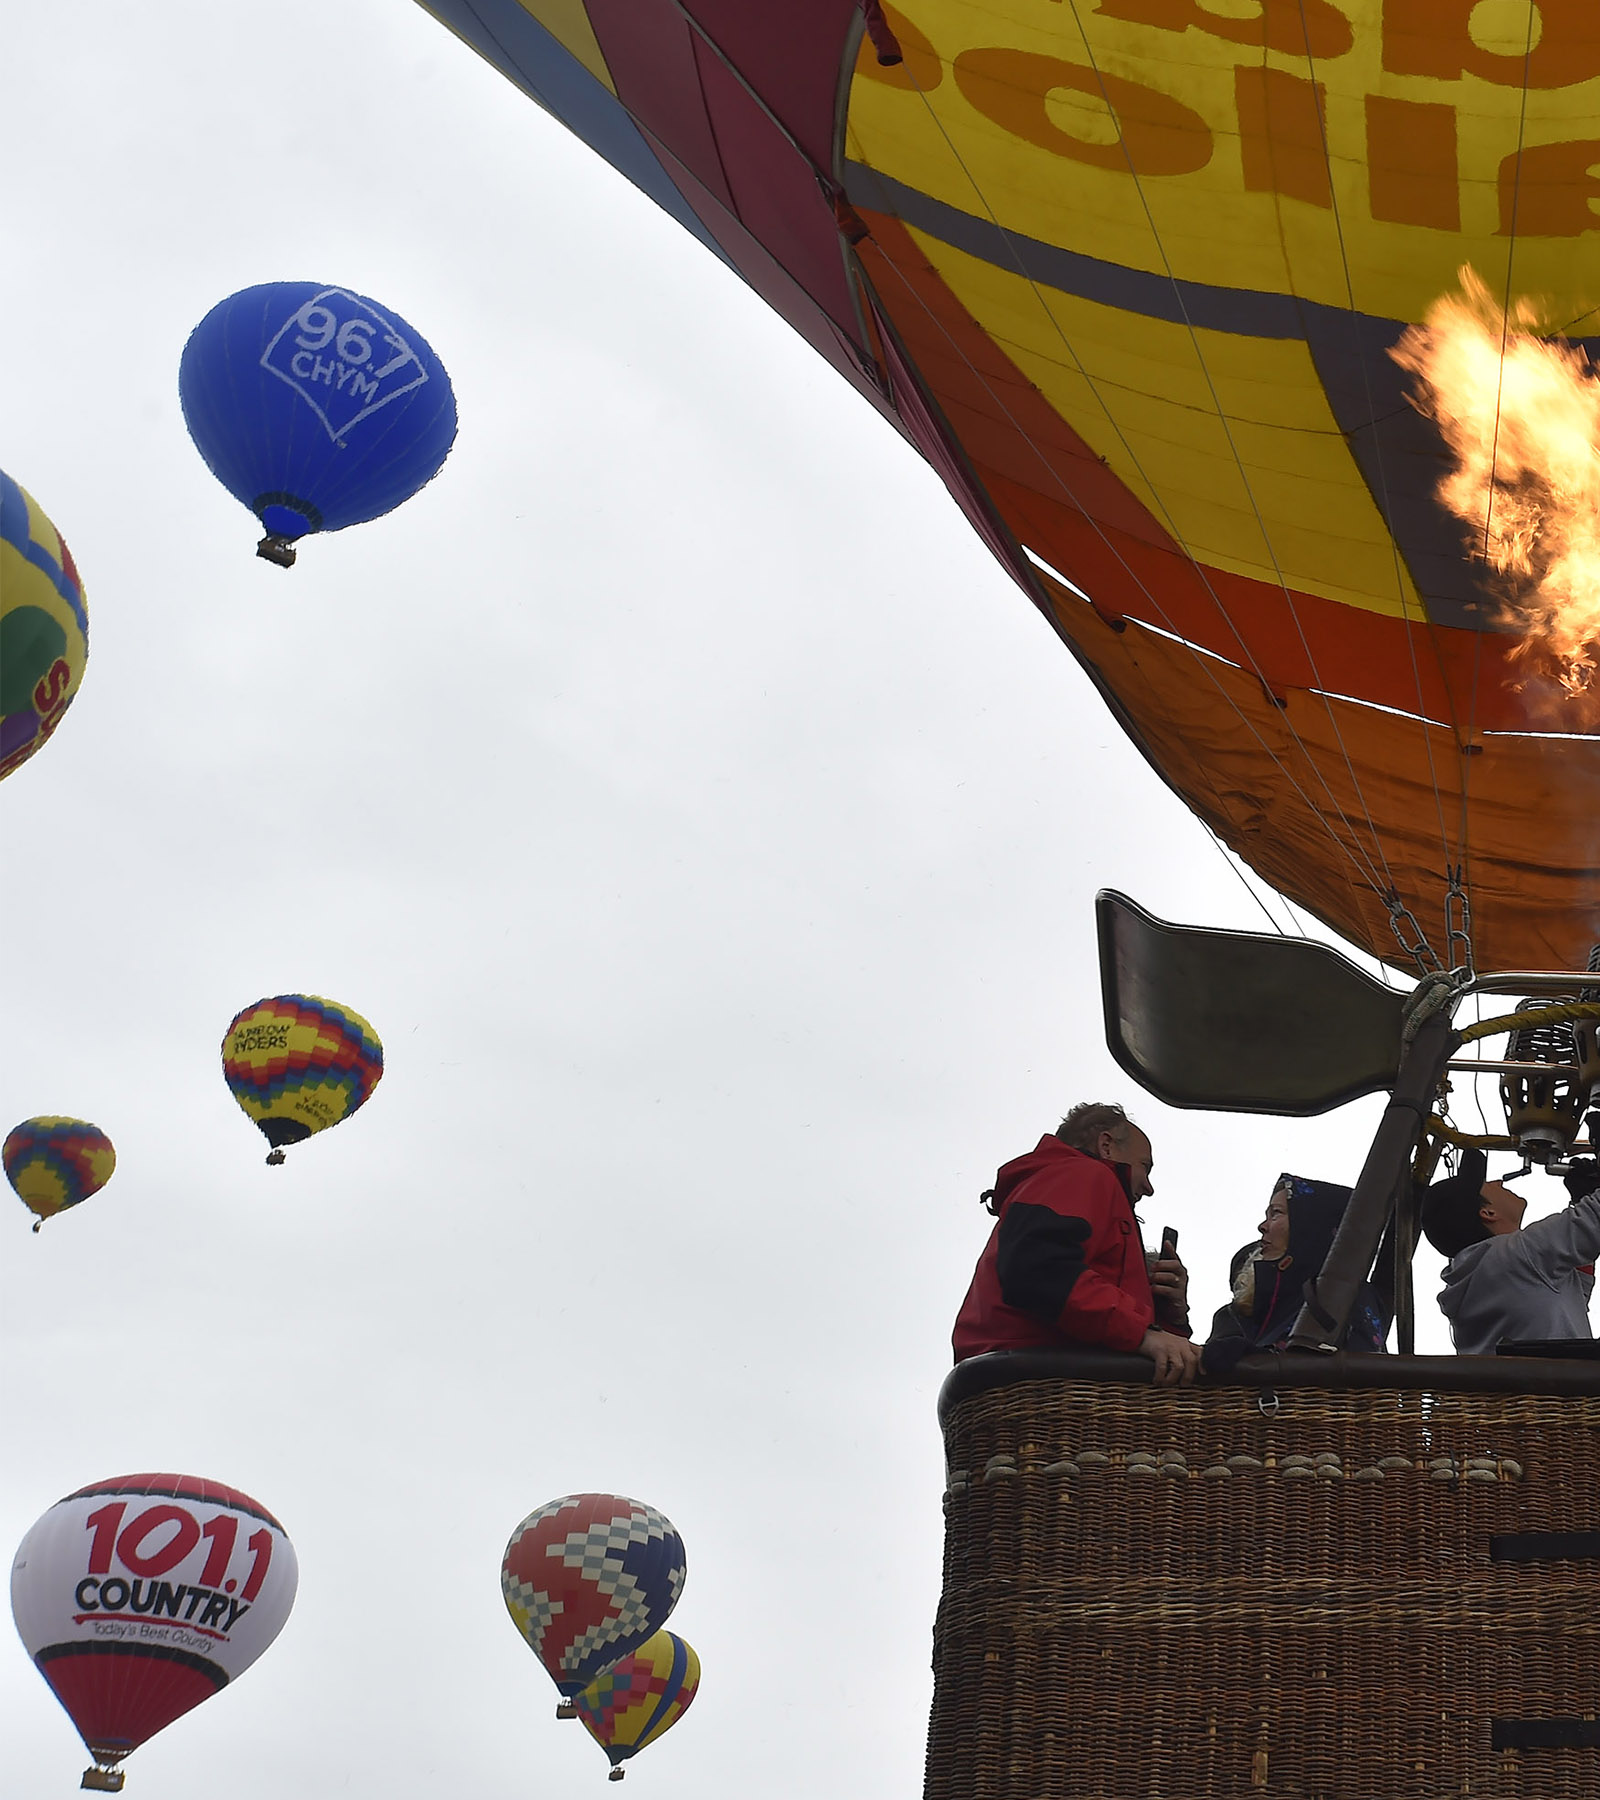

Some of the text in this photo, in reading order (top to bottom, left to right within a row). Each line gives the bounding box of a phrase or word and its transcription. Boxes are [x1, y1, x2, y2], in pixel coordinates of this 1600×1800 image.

[295, 305, 414, 378] 96.7
[291, 351, 379, 404] CHYM
[86, 1502, 273, 1602] 101.1
[75, 1577, 250, 1632] COUNTRY
[93, 1621, 215, 1654] Today's Best Country
